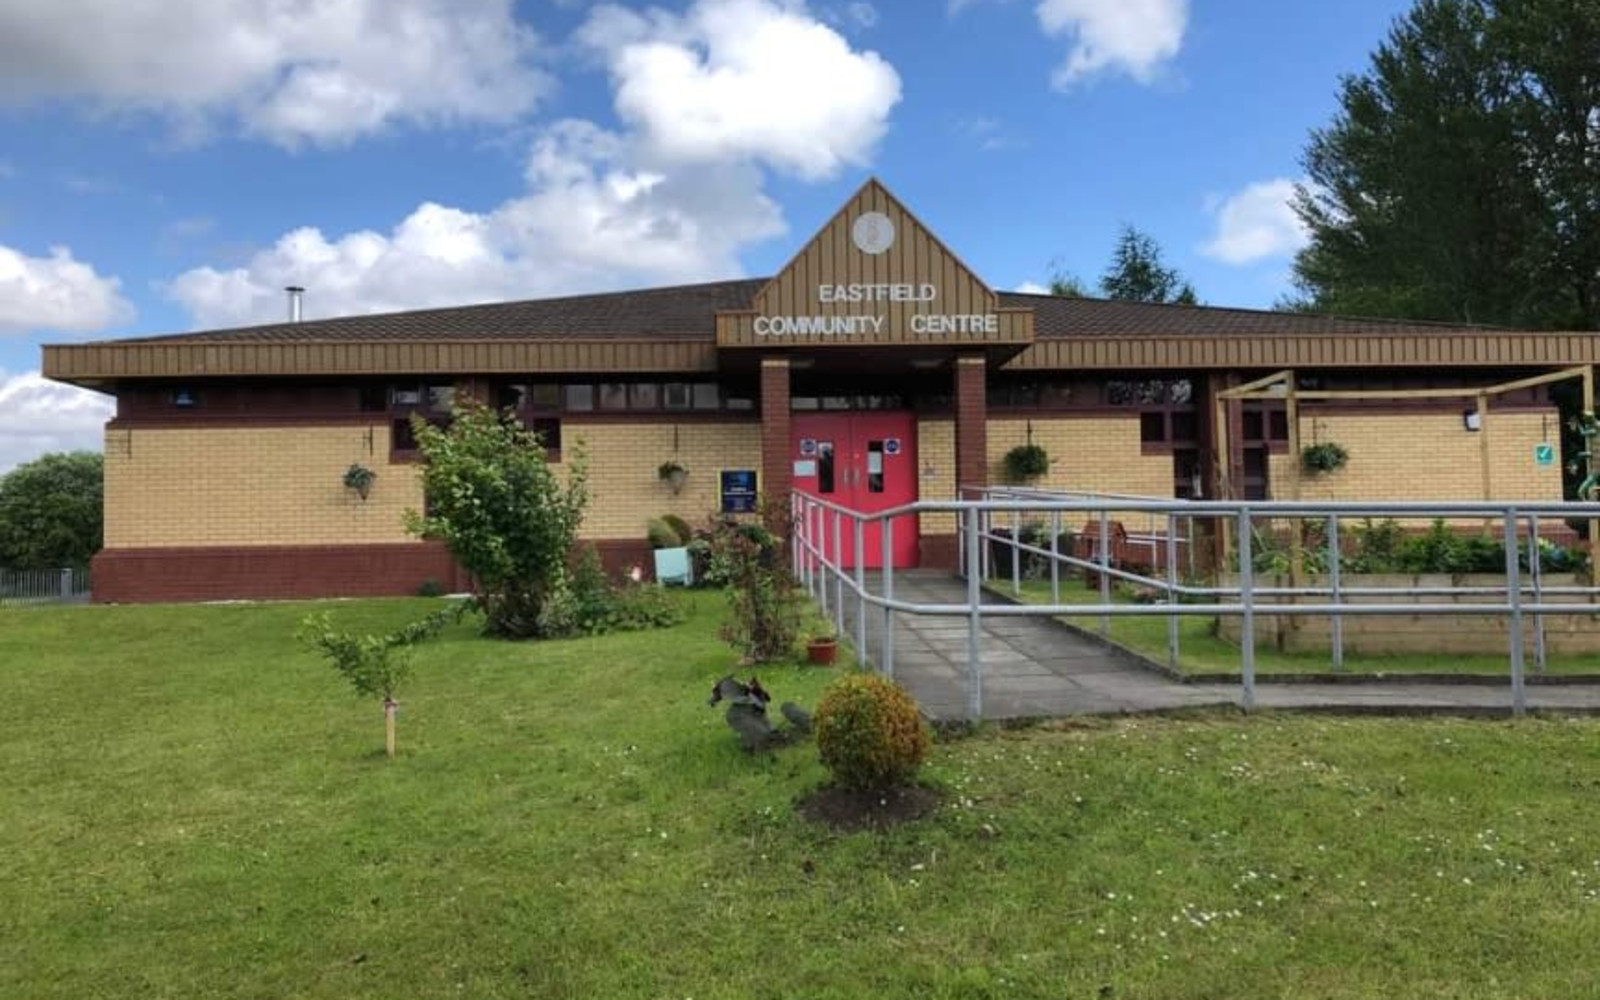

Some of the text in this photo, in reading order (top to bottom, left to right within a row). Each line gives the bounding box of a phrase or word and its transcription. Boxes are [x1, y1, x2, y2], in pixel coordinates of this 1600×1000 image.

[819, 284, 936, 302] EASTFIELD
[753, 314, 998, 335] COMMUNITY CENTRE
